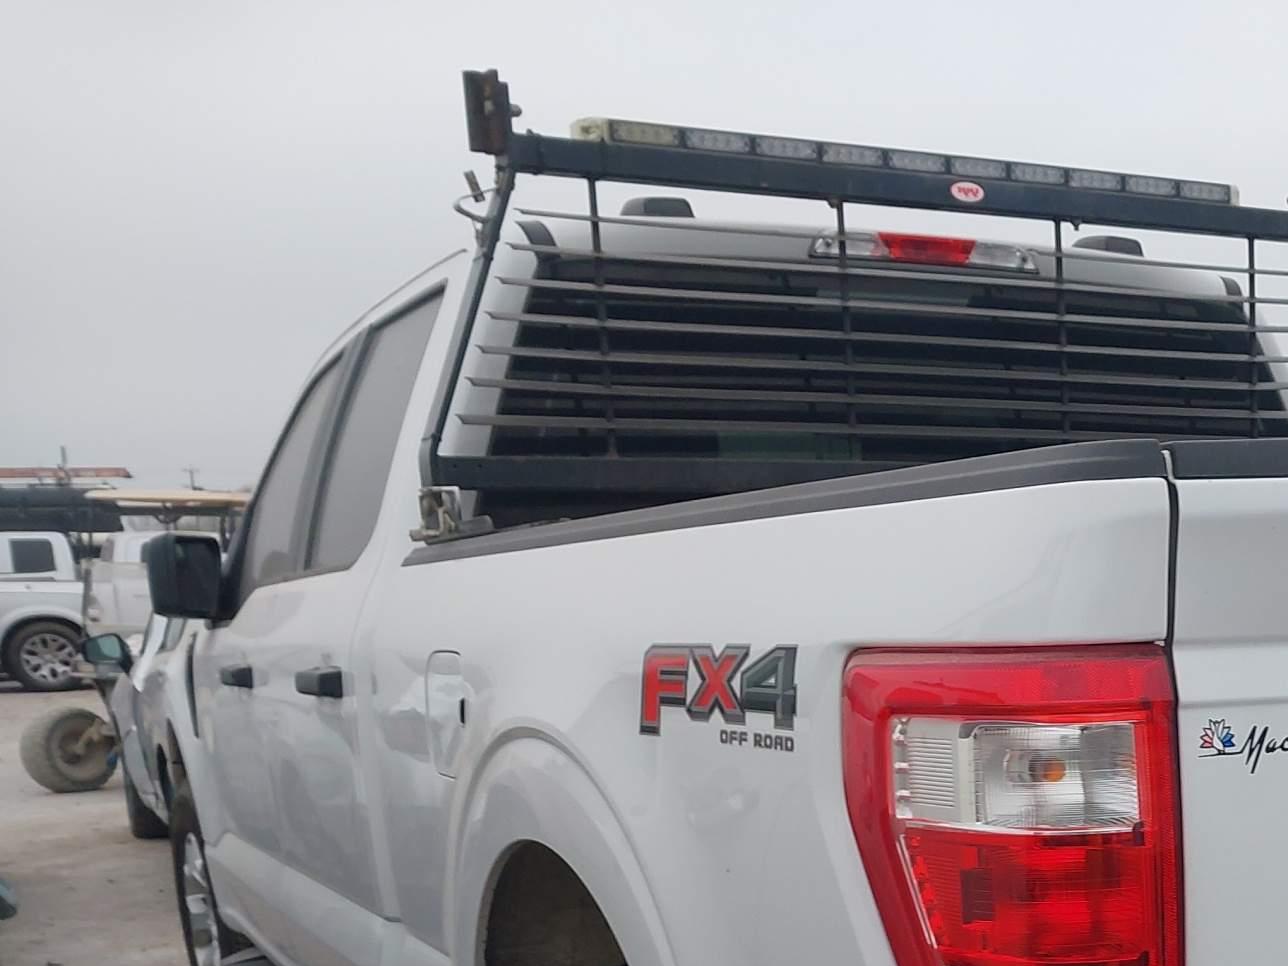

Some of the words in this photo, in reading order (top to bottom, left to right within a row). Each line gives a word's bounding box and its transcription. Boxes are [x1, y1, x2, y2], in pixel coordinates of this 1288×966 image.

[639, 643, 798, 736] FX4
[719, 729, 748, 746] OFF
[753, 733, 795, 752] ROAD
